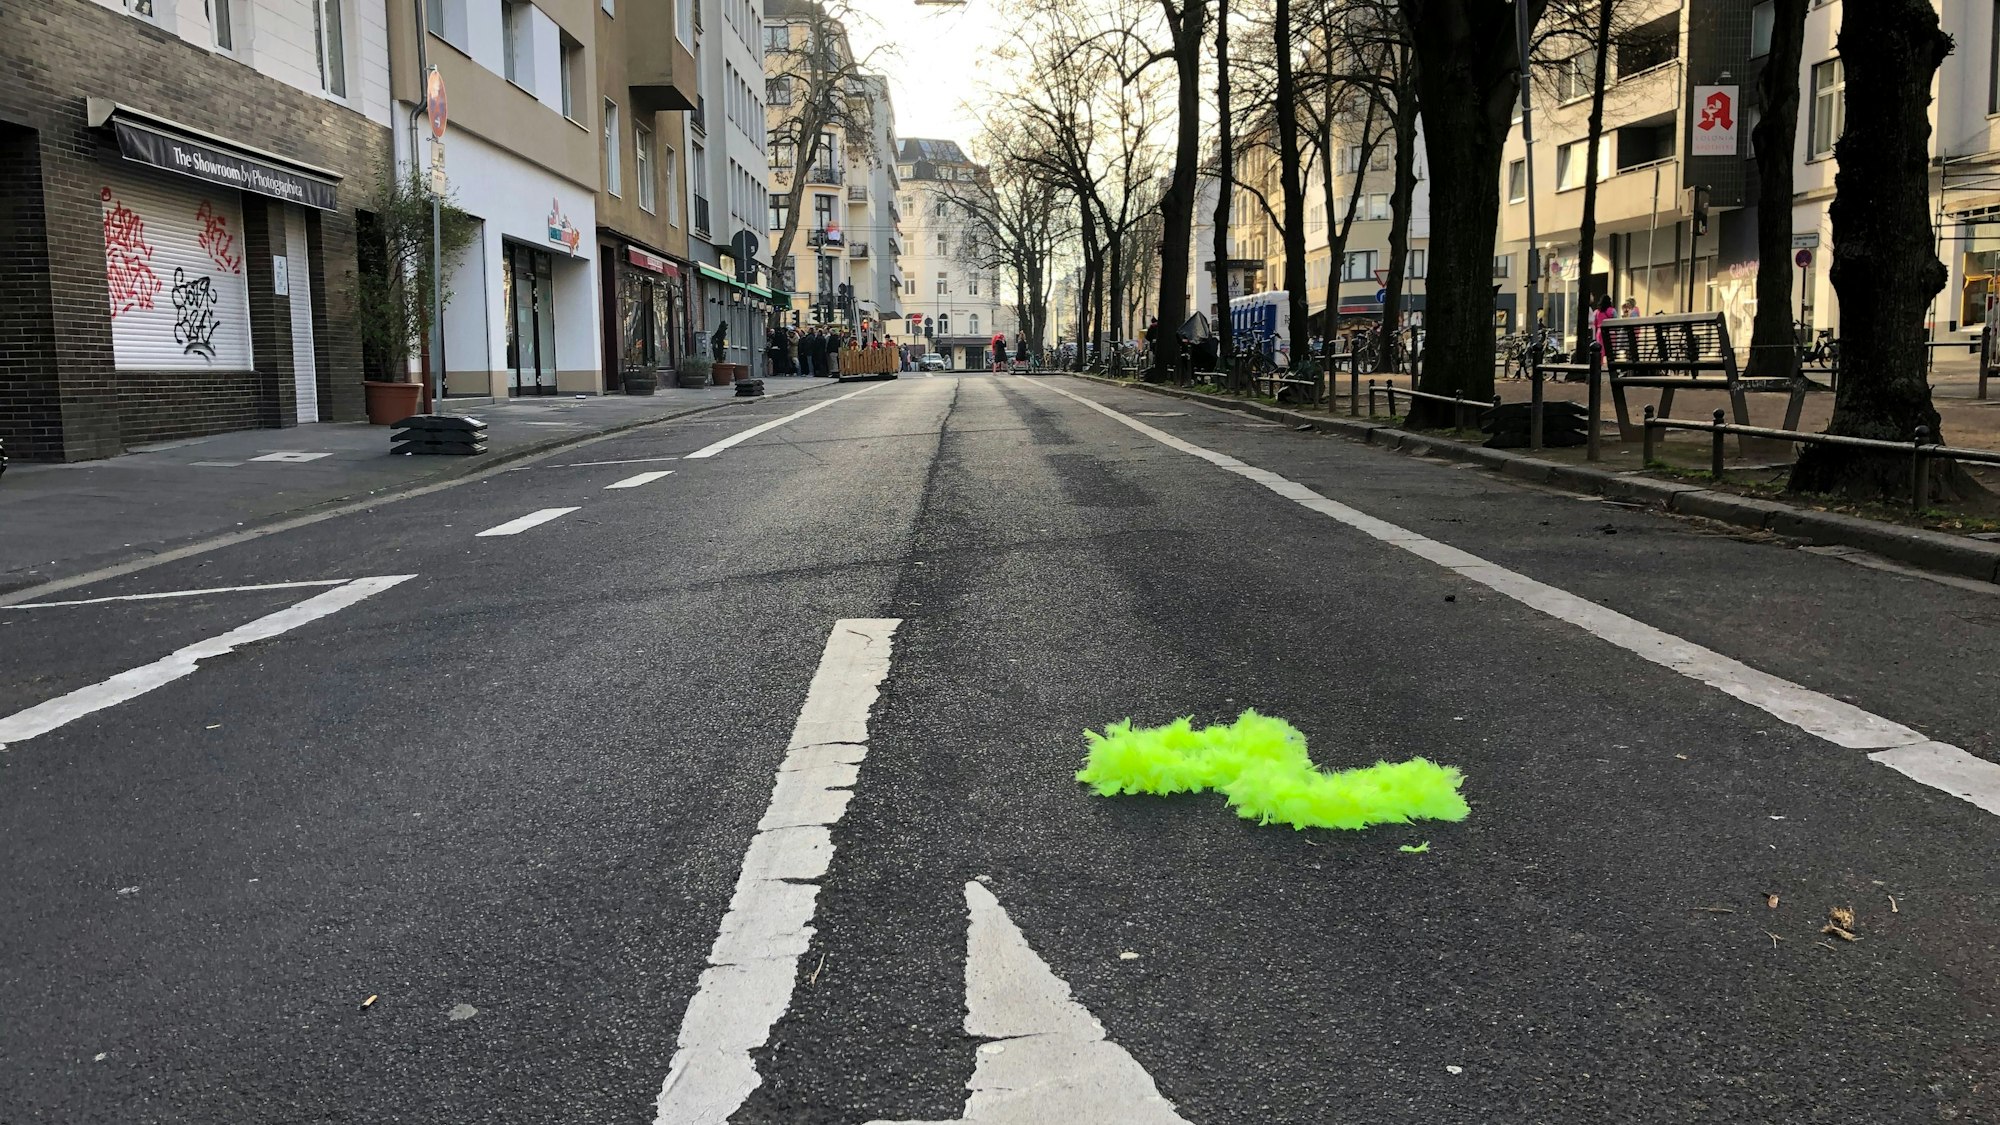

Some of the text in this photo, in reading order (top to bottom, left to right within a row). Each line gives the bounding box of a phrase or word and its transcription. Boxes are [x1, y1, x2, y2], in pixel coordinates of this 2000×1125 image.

[173, 146, 303, 198] The Showroom by Photographica
